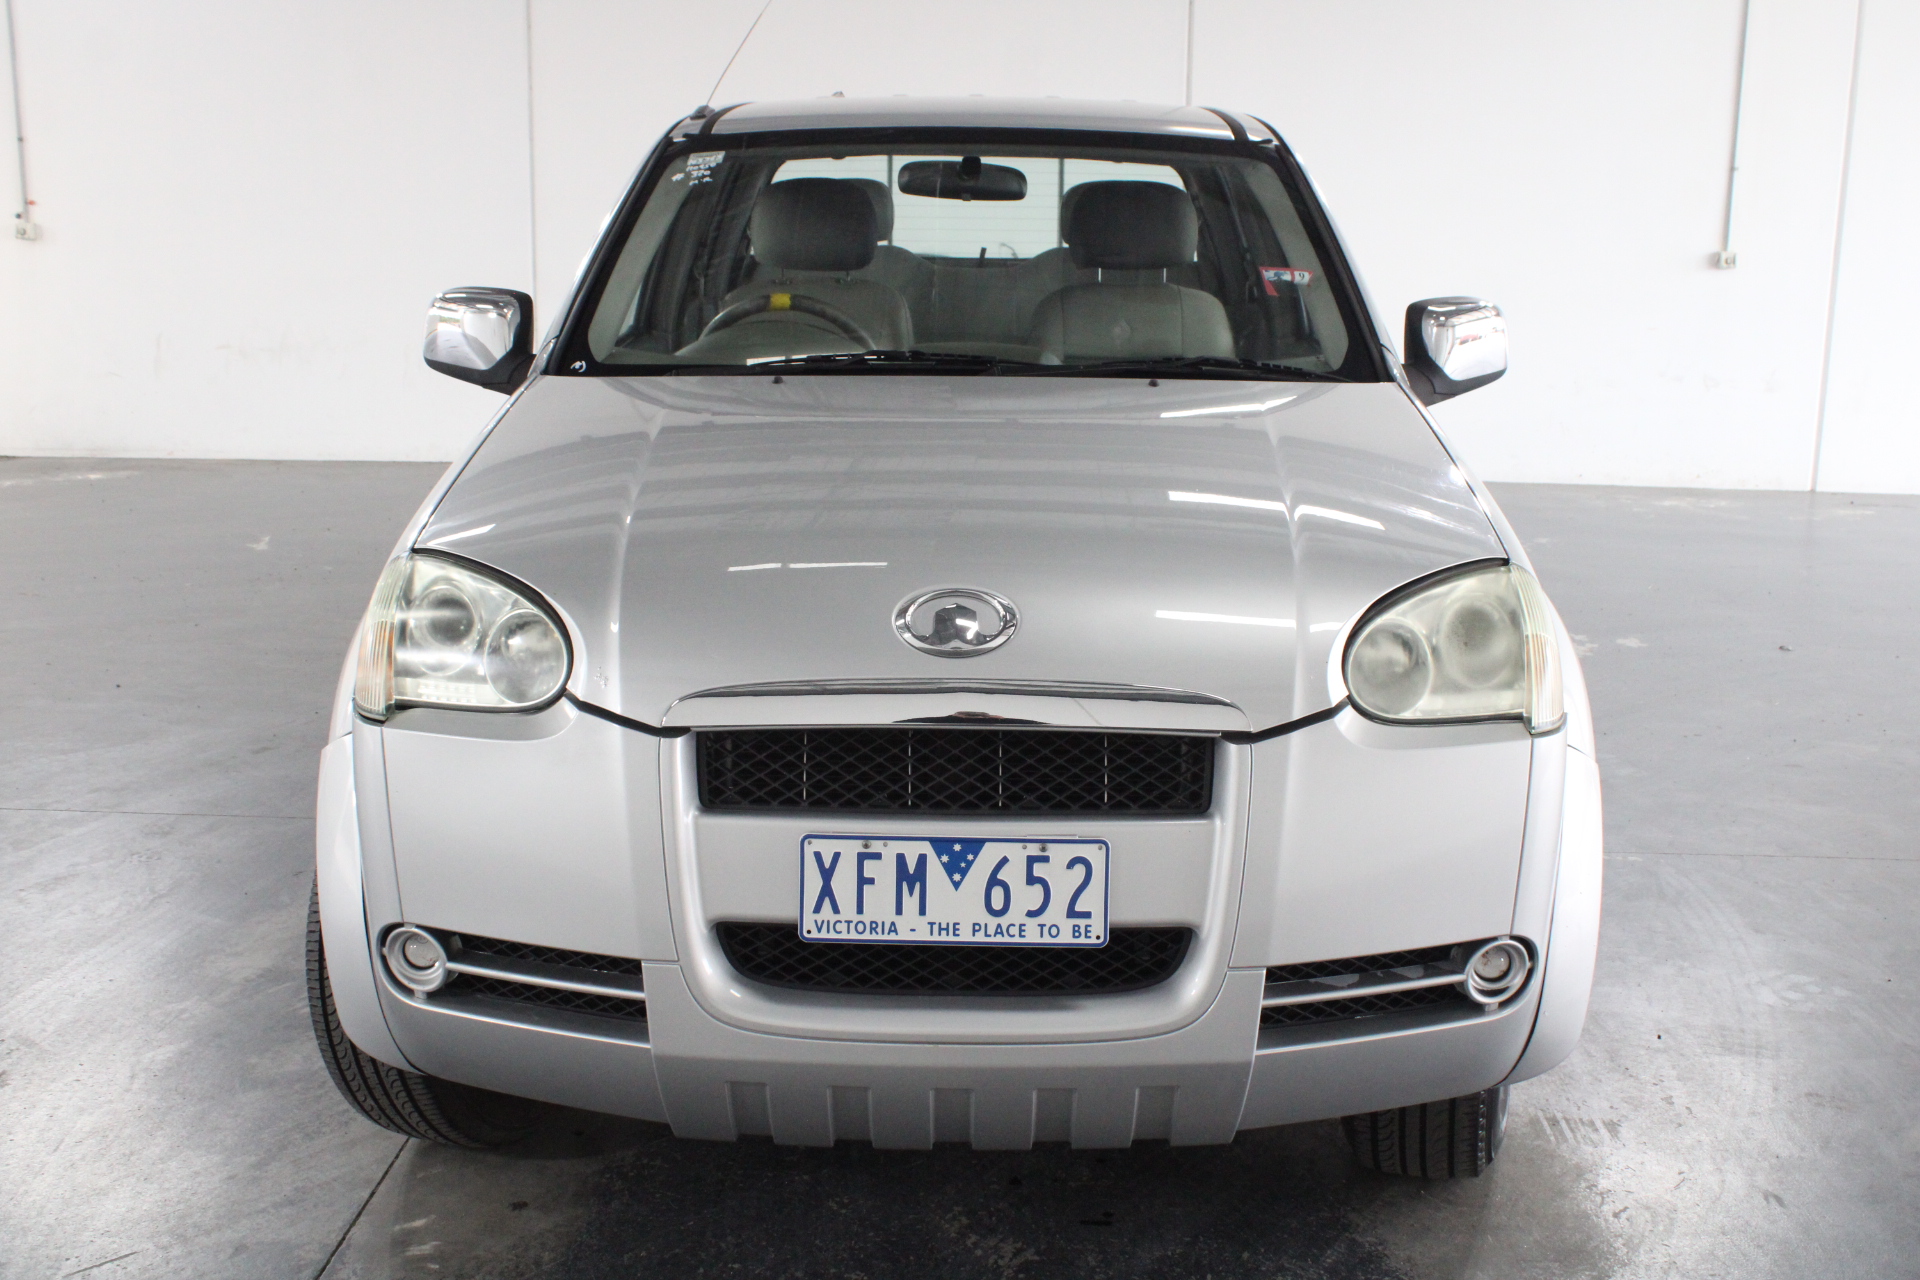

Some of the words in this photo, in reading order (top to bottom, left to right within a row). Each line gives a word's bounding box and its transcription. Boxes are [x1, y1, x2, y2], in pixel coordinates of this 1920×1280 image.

[812, 851, 928, 916] XFM
[984, 854, 1094, 919] 652
[814, 919, 899, 936] VICTORIA
[927, 921, 961, 937] THE
[972, 922, 1027, 938] PLACE
[1037, 923, 1061, 939] TO
[1072, 924, 1093, 939] BE
